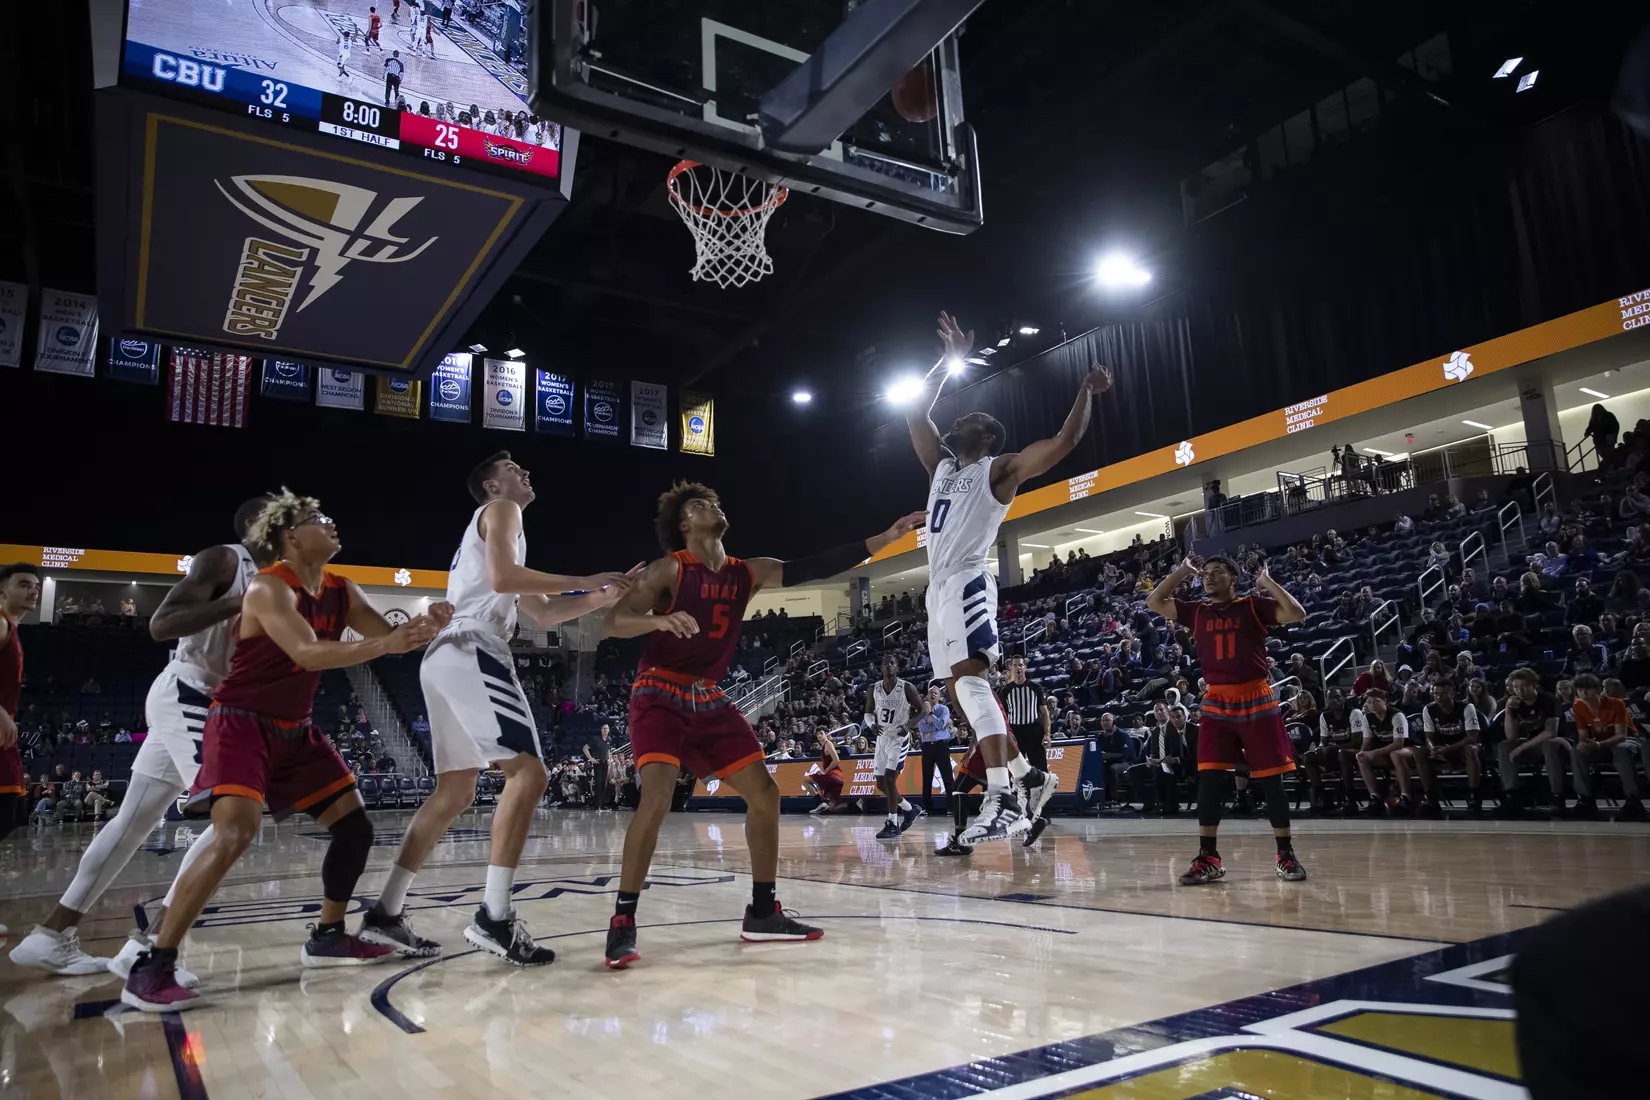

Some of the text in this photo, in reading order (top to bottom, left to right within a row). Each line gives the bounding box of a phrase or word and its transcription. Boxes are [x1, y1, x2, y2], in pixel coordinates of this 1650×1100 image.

[152, 52, 228, 93] CBU
[260, 79, 288, 108] 32
[248, 104, 291, 123] FLS 5
[342, 101, 381, 128] 8:00
[332, 124, 391, 148] 1ST HALF
[434, 123, 459, 150] 25
[423, 148, 461, 165] FLS 5
[489, 145, 530, 166] SPIRIT
[223, 237, 310, 340] LANCERS
[54, 297, 86, 310] 2014
[108, 358, 156, 371] CHAMPIONS
[493, 365, 517, 376] 2016
[264, 376, 308, 388] CHAMPIONS
[490, 374, 519, 384] WOMEN'S
[544, 371, 567, 382] 2017
[320, 383, 362, 394] WEST REGION
[486, 380, 524, 391] BASKETBALL
[538, 386, 574, 397] BASKETBALL
[541, 380, 570, 390] WOMEN'S
[592, 380, 615, 390] 2017
[321, 390, 360, 400] CHAMPIONS
[379, 392, 410, 402] DIVISION
[430, 400, 469, 411] CHAMPIONS
[491, 407, 514, 416] DIVISION
[1284, 395, 1328, 415] RIVERSIDE
[538, 415, 573, 425] CHAMPIONS
[1286, 407, 1323, 424] MEDICAL
[1287, 419, 1314, 434] CLINIC
[1069, 470, 1099, 485] RIVERSIDE
[1069, 480, 1096, 494] MEDICAL
[930, 499, 952, 534] 0
[41, 553, 79, 562] MEDICAL
[42, 546, 86, 556] RIVERSIDE
[41, 561, 69, 569] CLINIC
[700, 583, 738, 600] OUAZ
[709, 603, 730, 639] 5
[1215, 631, 1236, 661] 11
[881, 708, 896, 723] 31
[849, 784, 875, 796] CLINIC
